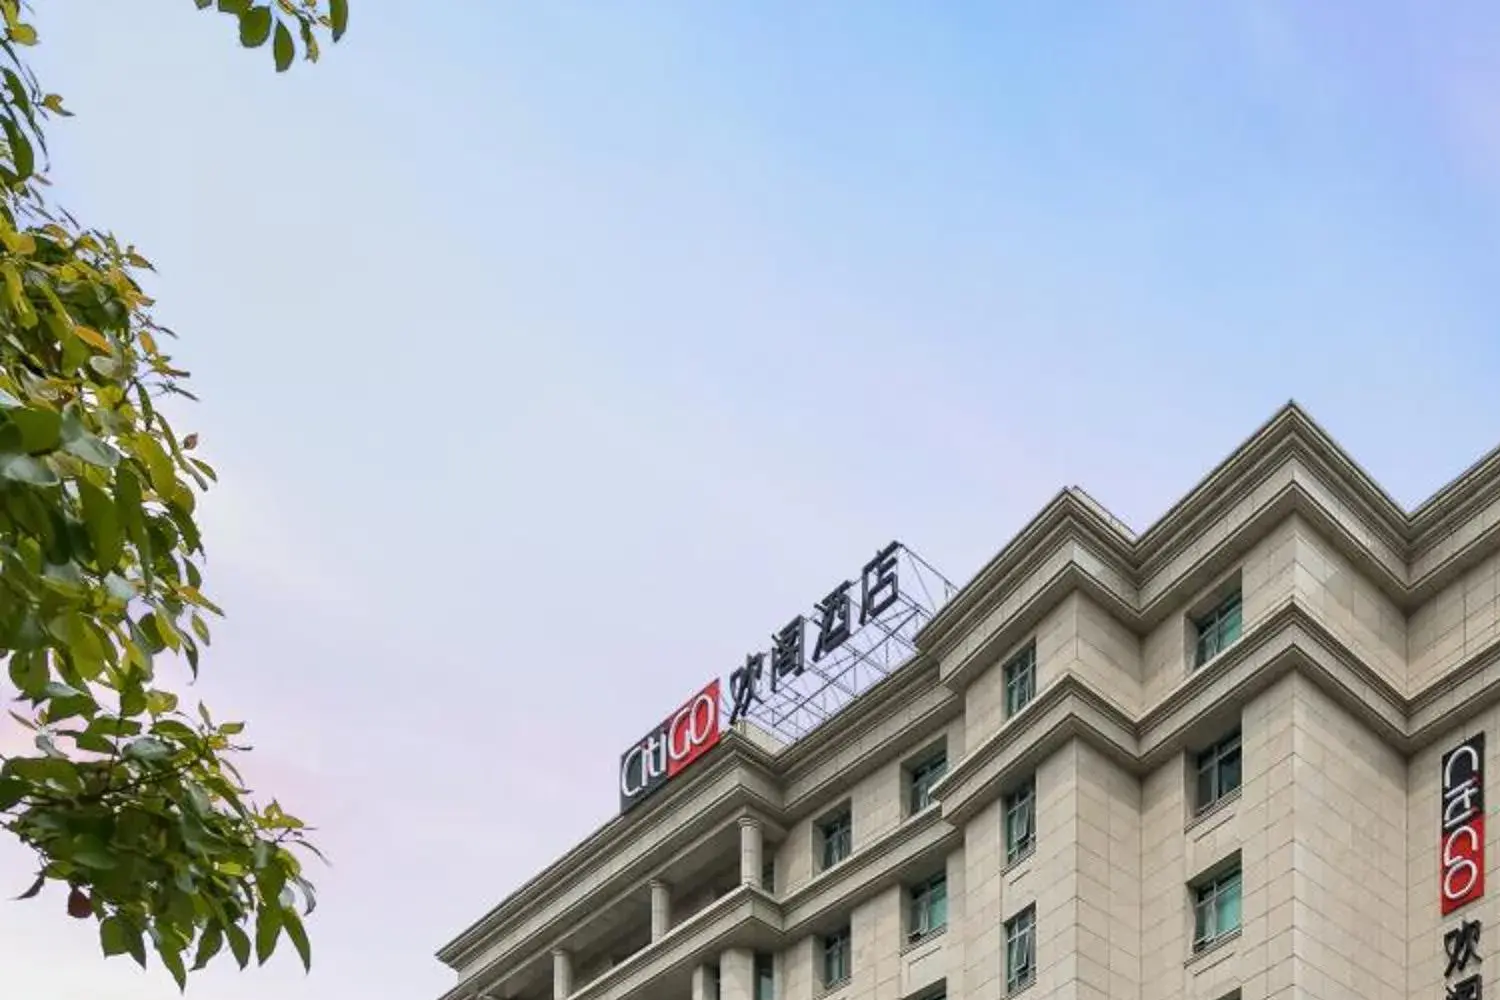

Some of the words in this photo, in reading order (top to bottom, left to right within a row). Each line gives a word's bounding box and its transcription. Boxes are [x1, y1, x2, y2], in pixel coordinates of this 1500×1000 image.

[729, 540, 903, 725] 欢阁酒店
[622, 692, 715, 798] CitiGO
